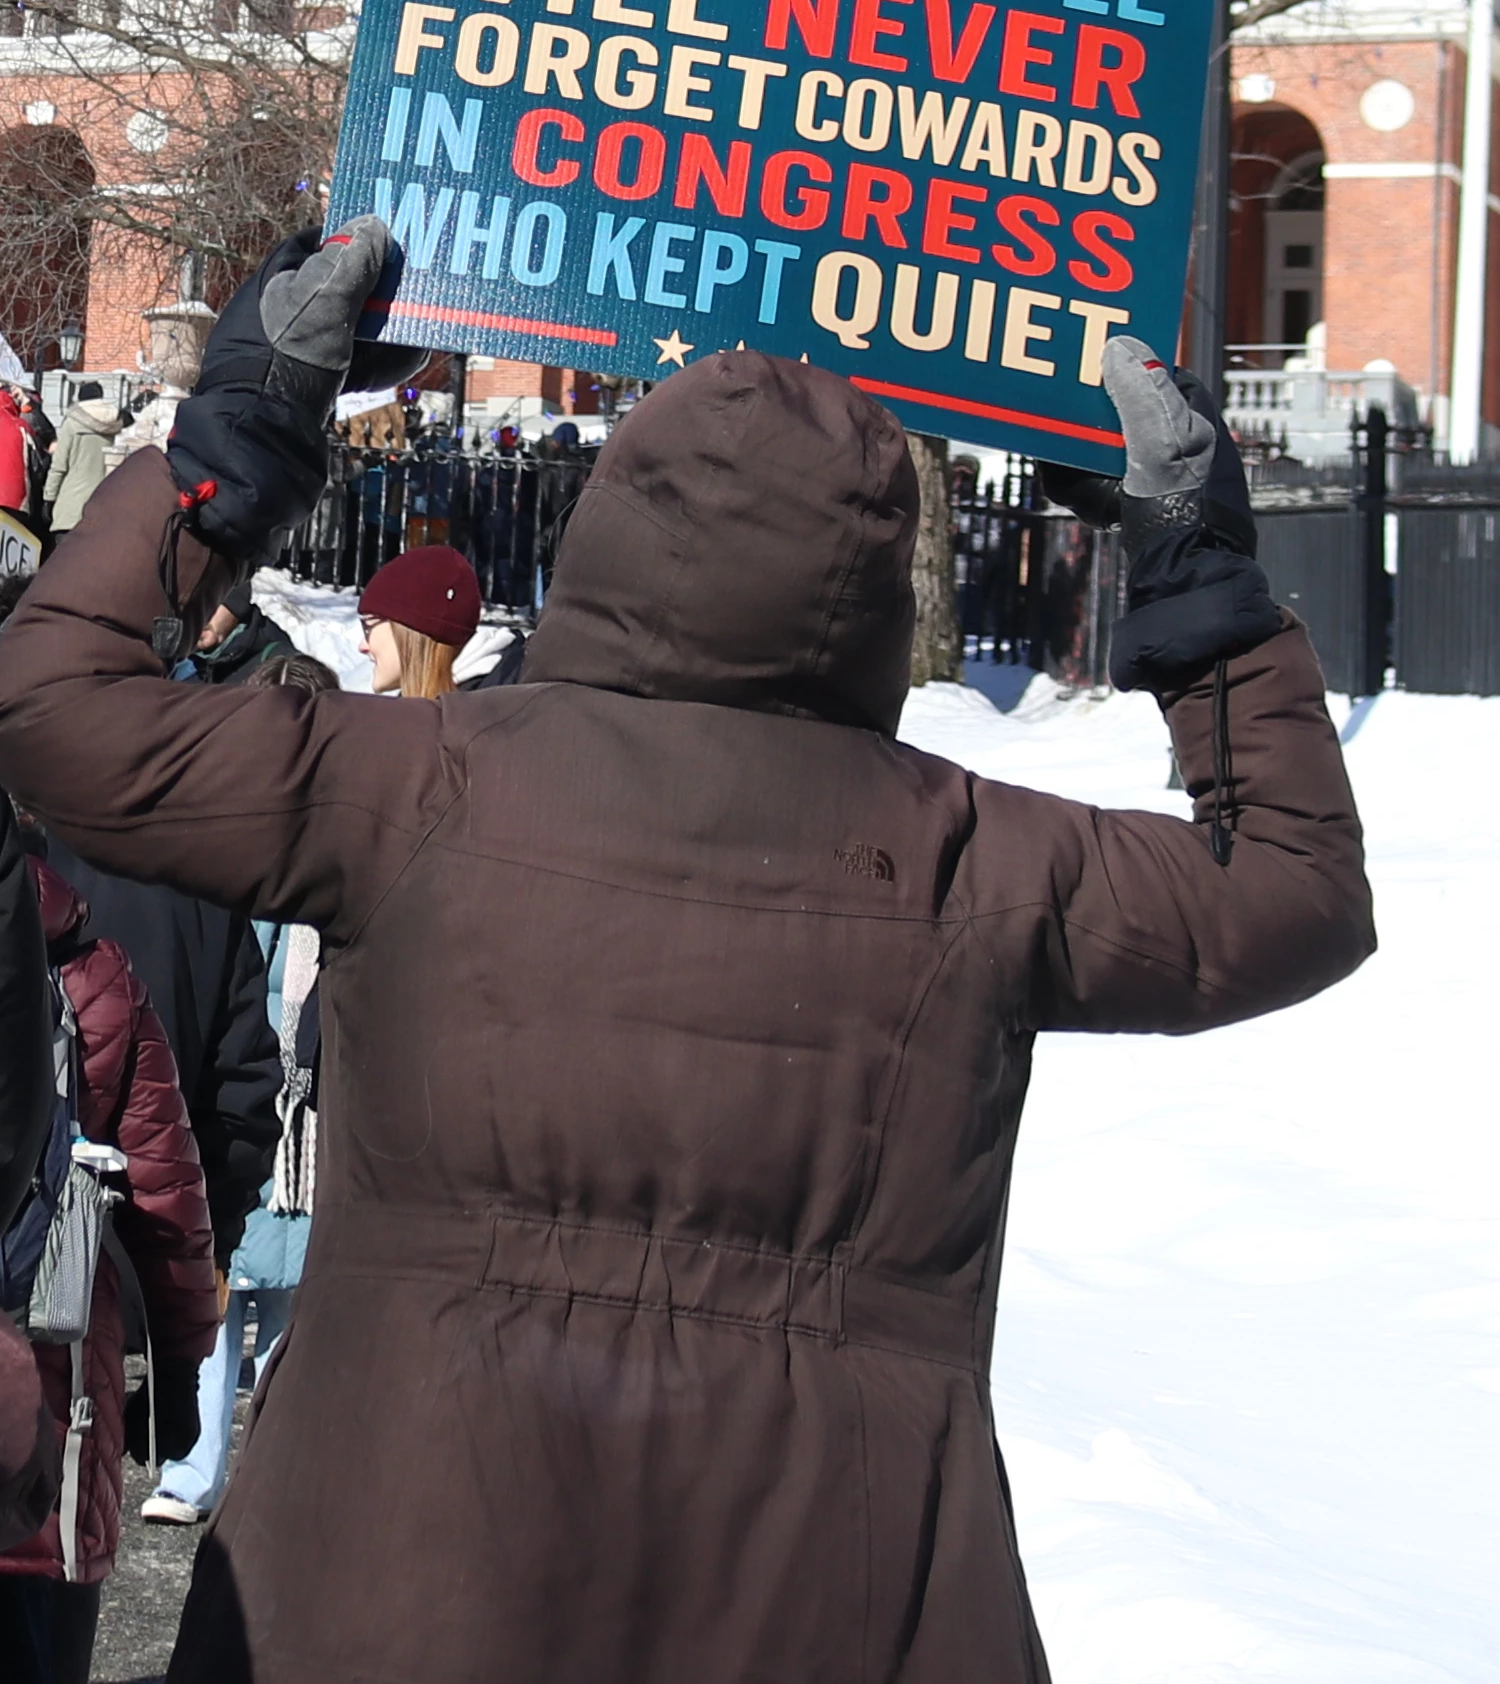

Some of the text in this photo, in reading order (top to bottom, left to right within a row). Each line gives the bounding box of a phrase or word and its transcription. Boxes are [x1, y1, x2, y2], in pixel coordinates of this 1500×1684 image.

[394, 1, 1162, 207] FORGET COWARDS
[380, 87, 1135, 292] IN CONGRESS
[374, 177, 1131, 387] WHO KEPT QUIET
[0, 529, 31, 575] ICE
[834, 848, 877, 868] NORTH
[845, 863, 875, 878] FACE
[856, 843, 877, 857] THE
